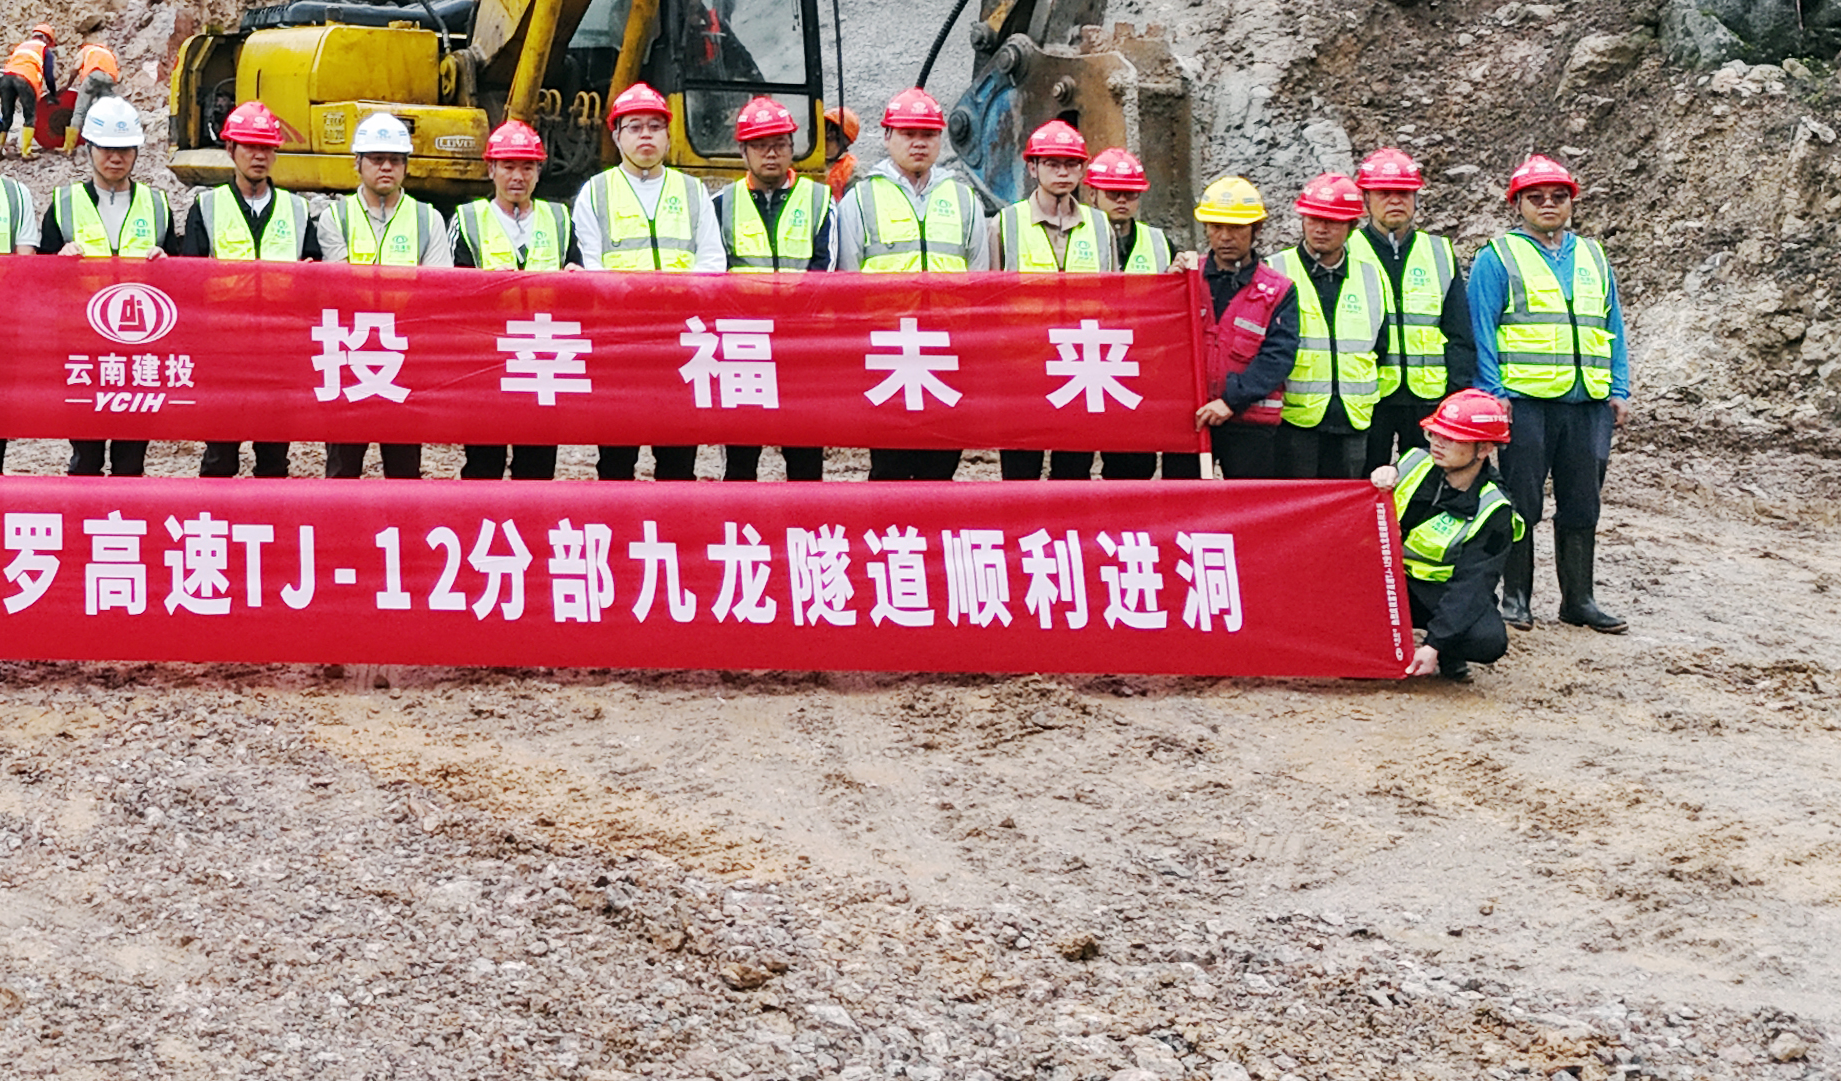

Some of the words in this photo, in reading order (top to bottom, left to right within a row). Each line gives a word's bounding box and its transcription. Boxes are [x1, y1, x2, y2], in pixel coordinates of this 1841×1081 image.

[64, 352, 195, 388] 云南建投
[311, 308, 1143, 413] 投幸福未来
[94, 392, 166, 413] YCIH
